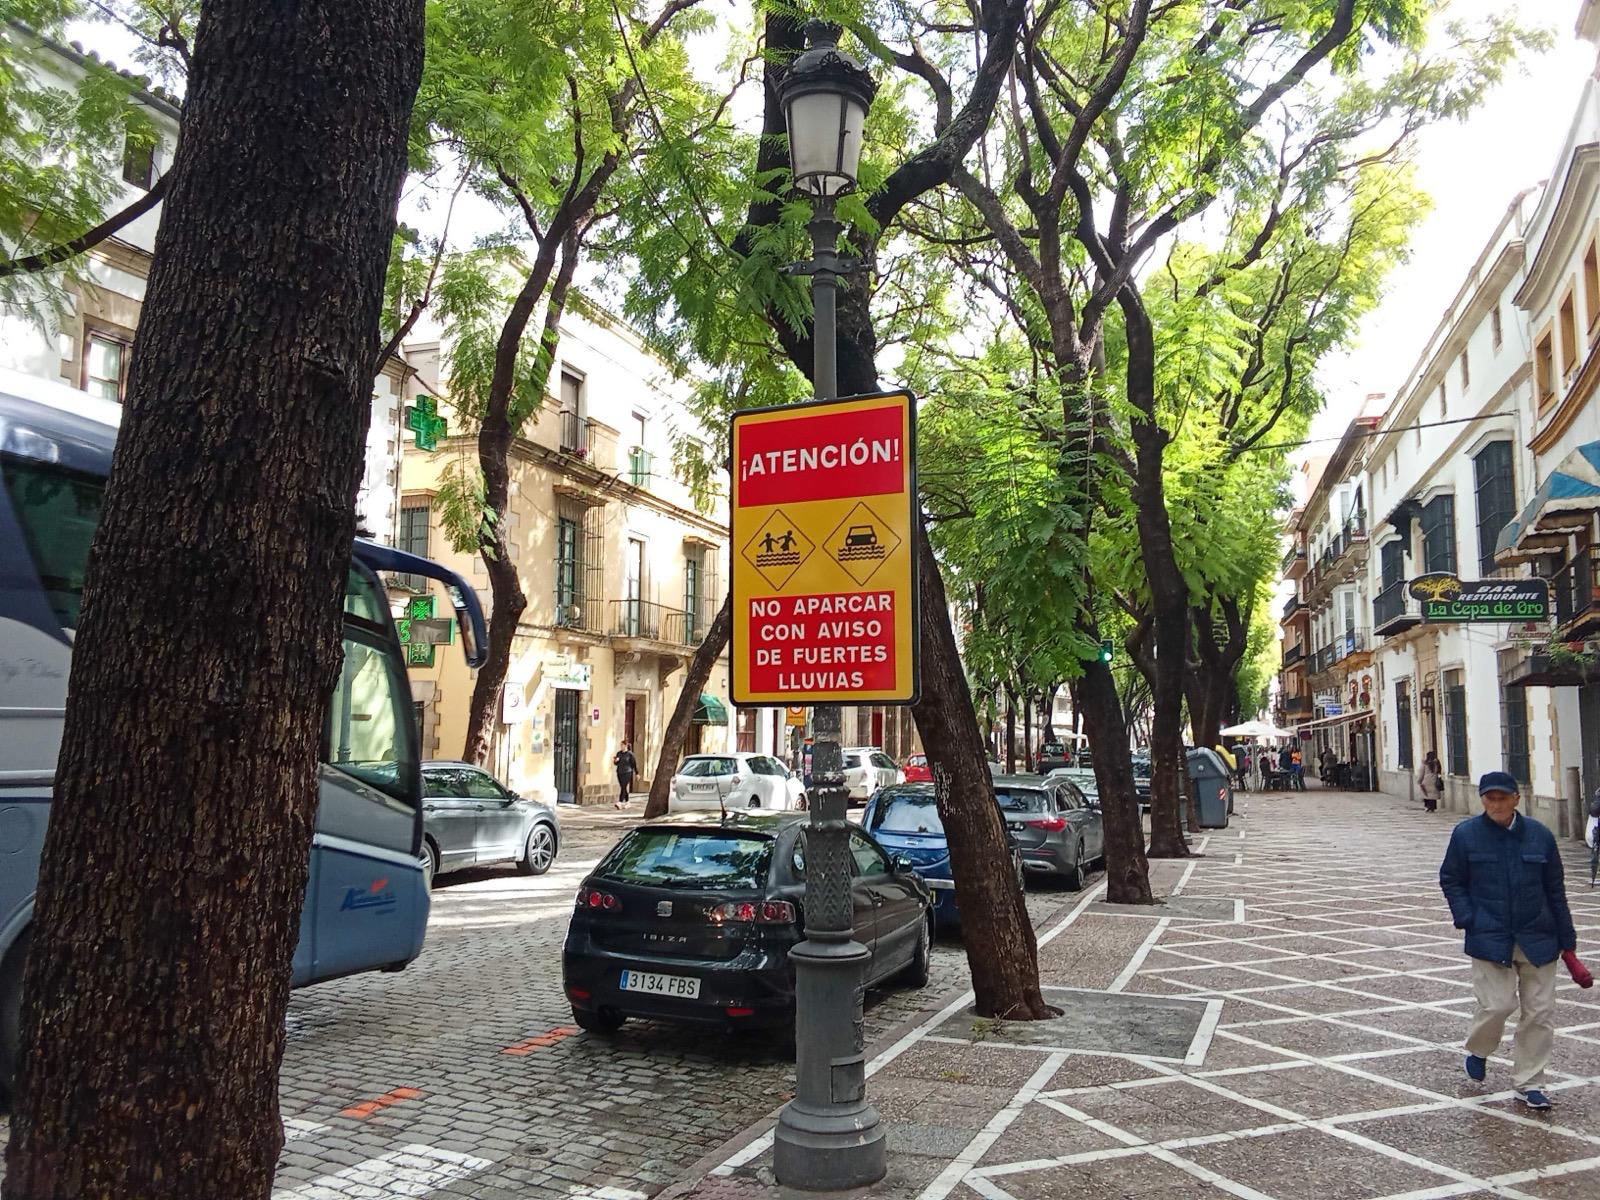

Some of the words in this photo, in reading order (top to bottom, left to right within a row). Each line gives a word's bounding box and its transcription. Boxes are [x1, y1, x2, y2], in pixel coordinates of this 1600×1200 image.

[741, 437, 900, 482] ¡ATENCIÓN!
[751, 600, 781, 617] NO
[793, 594, 892, 616] APARCAR
[1458, 593, 1540, 601] RESTAURANTE
[1428, 602, 1447, 616] La
[1451, 601, 1489, 620] Cepa
[1493, 601, 1513, 615] de
[1517, 600, 1544, 615] Oro
[760, 623, 805, 641] CON
[817, 619, 882, 639] AVISO
[756, 649, 782, 666] DE
[793, 645, 887, 665] FUERTES
[778, 671, 864, 690] LLUVIAS
[643, 933, 687, 943] IBIZA
[629, 973, 664, 992] 3134
[668, 977, 696, 996] FBS
